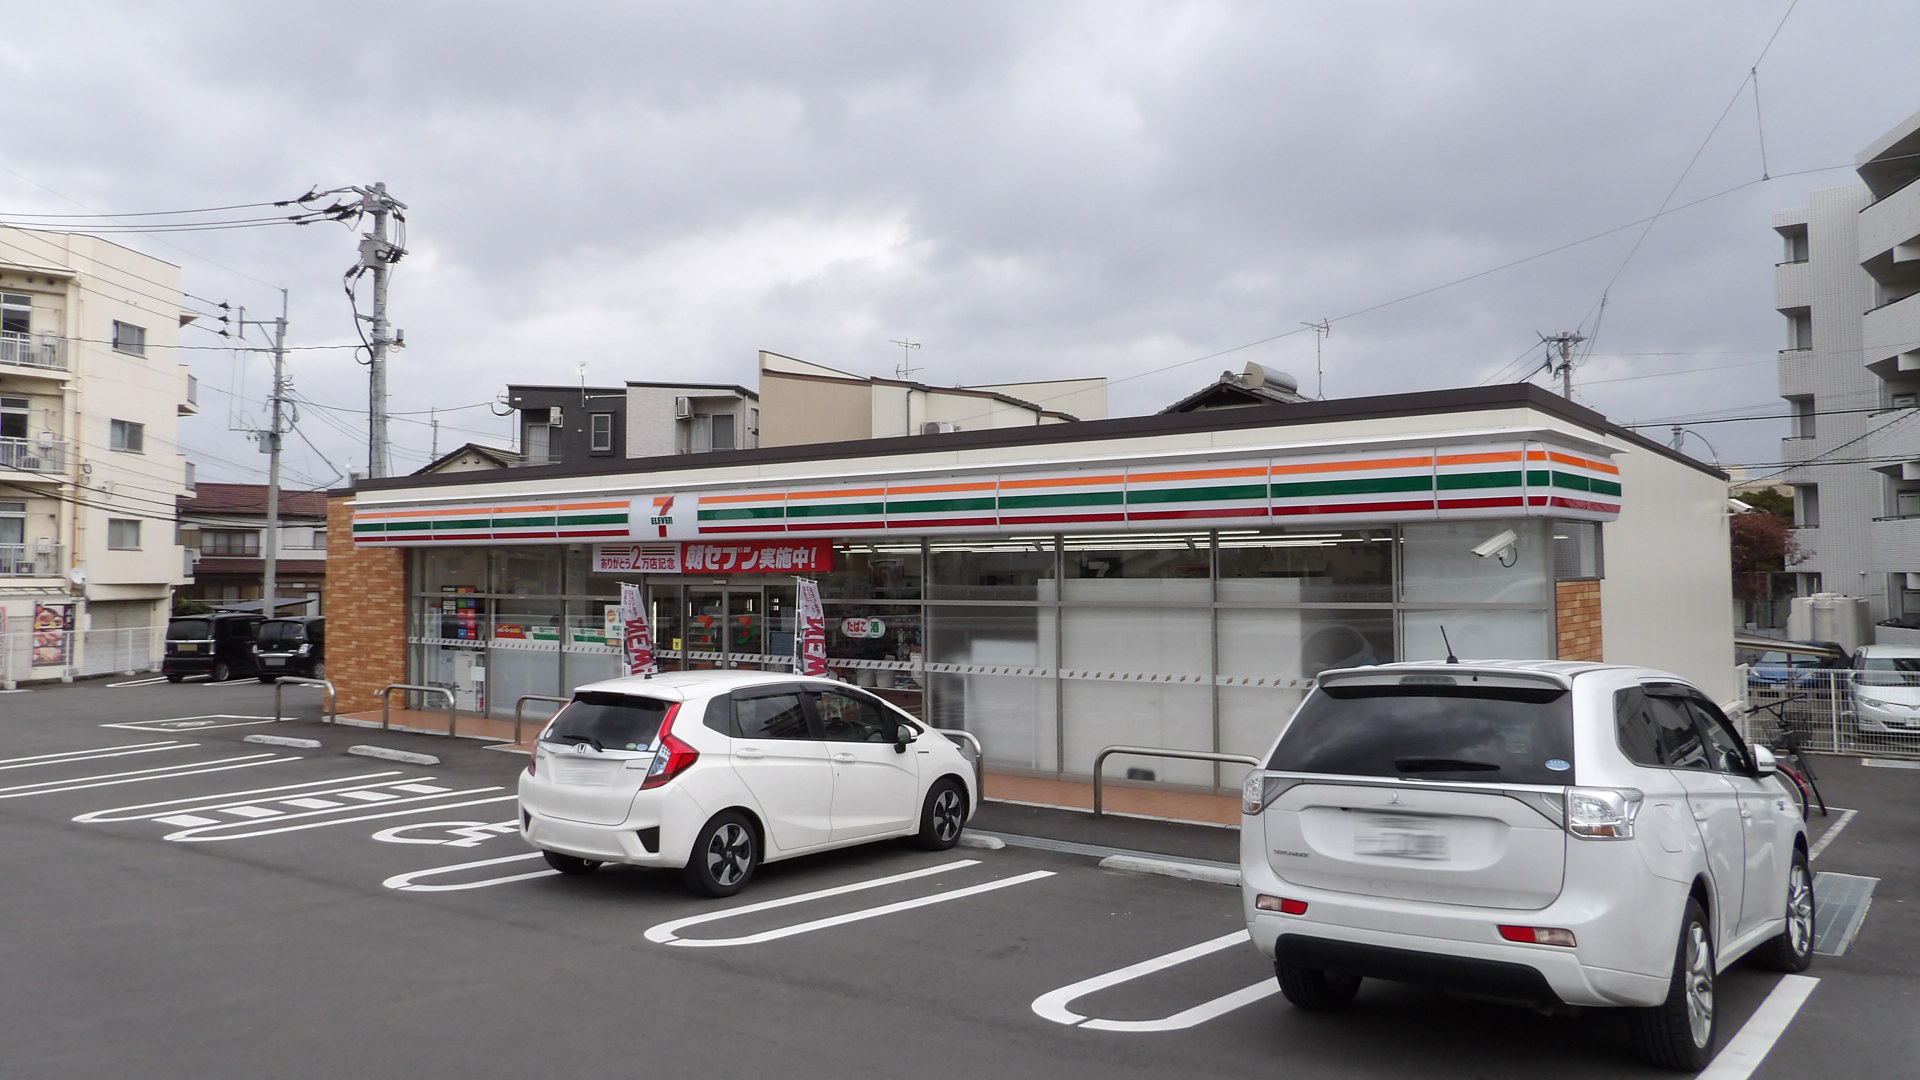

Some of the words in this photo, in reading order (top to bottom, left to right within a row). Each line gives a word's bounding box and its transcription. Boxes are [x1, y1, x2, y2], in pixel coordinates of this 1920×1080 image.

[653, 496, 675, 537] 7
[601, 545, 676, 569] ありがとう2万店記念
[685, 545, 817, 570] 朝セブン実施中!
[847, 621, 867, 632] たばこ
[871, 621, 880, 633] 酒
